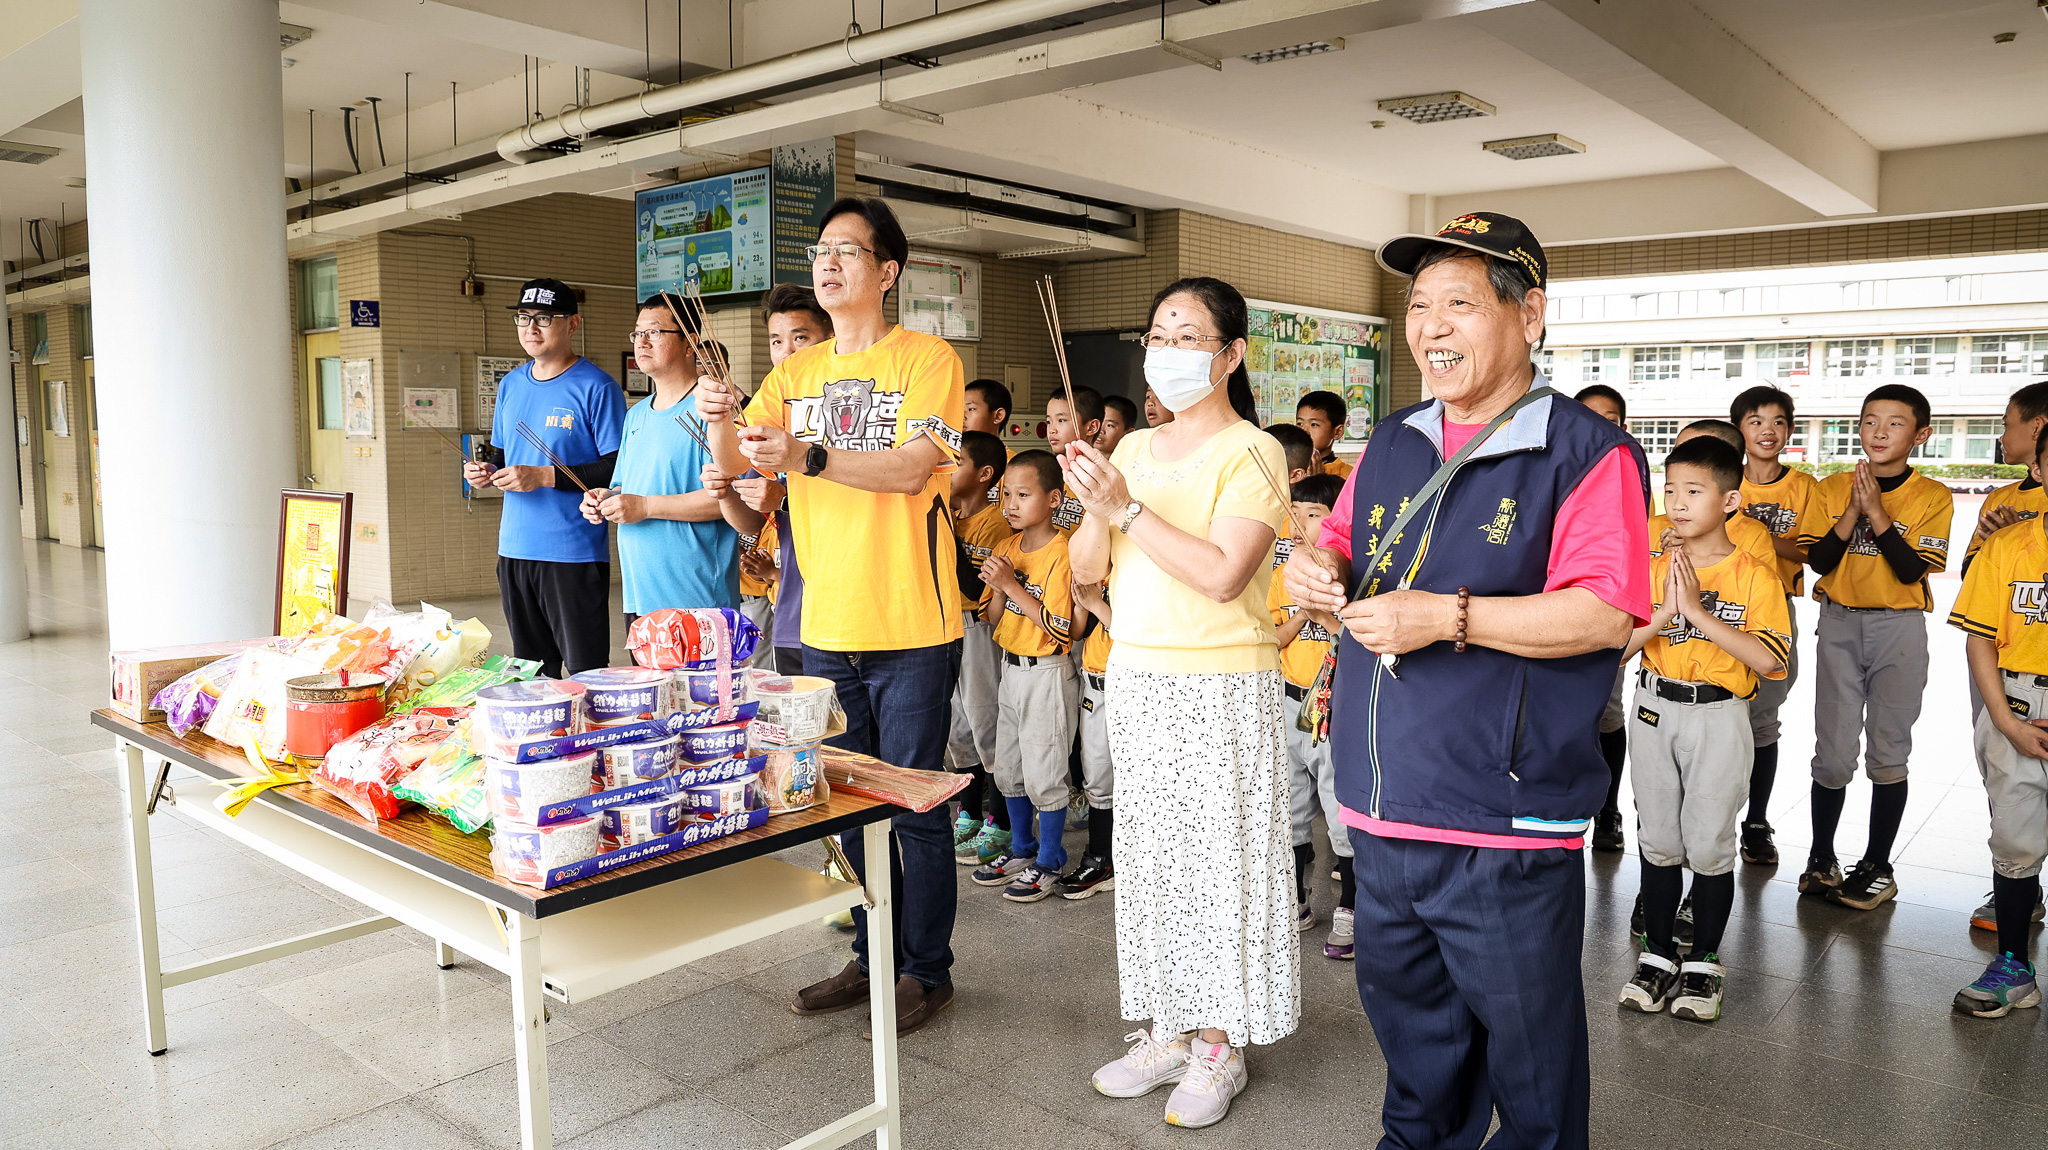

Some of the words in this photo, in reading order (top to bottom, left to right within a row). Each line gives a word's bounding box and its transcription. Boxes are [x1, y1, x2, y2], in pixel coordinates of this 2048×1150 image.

[574, 733, 621, 748] WeiLih
[621, 728, 652, 739] Men
[592, 792, 637, 808] WeiLih
[637, 786, 666, 797] Men
[598, 850, 642, 869] WeiLih
[642, 843, 670, 856] Men
